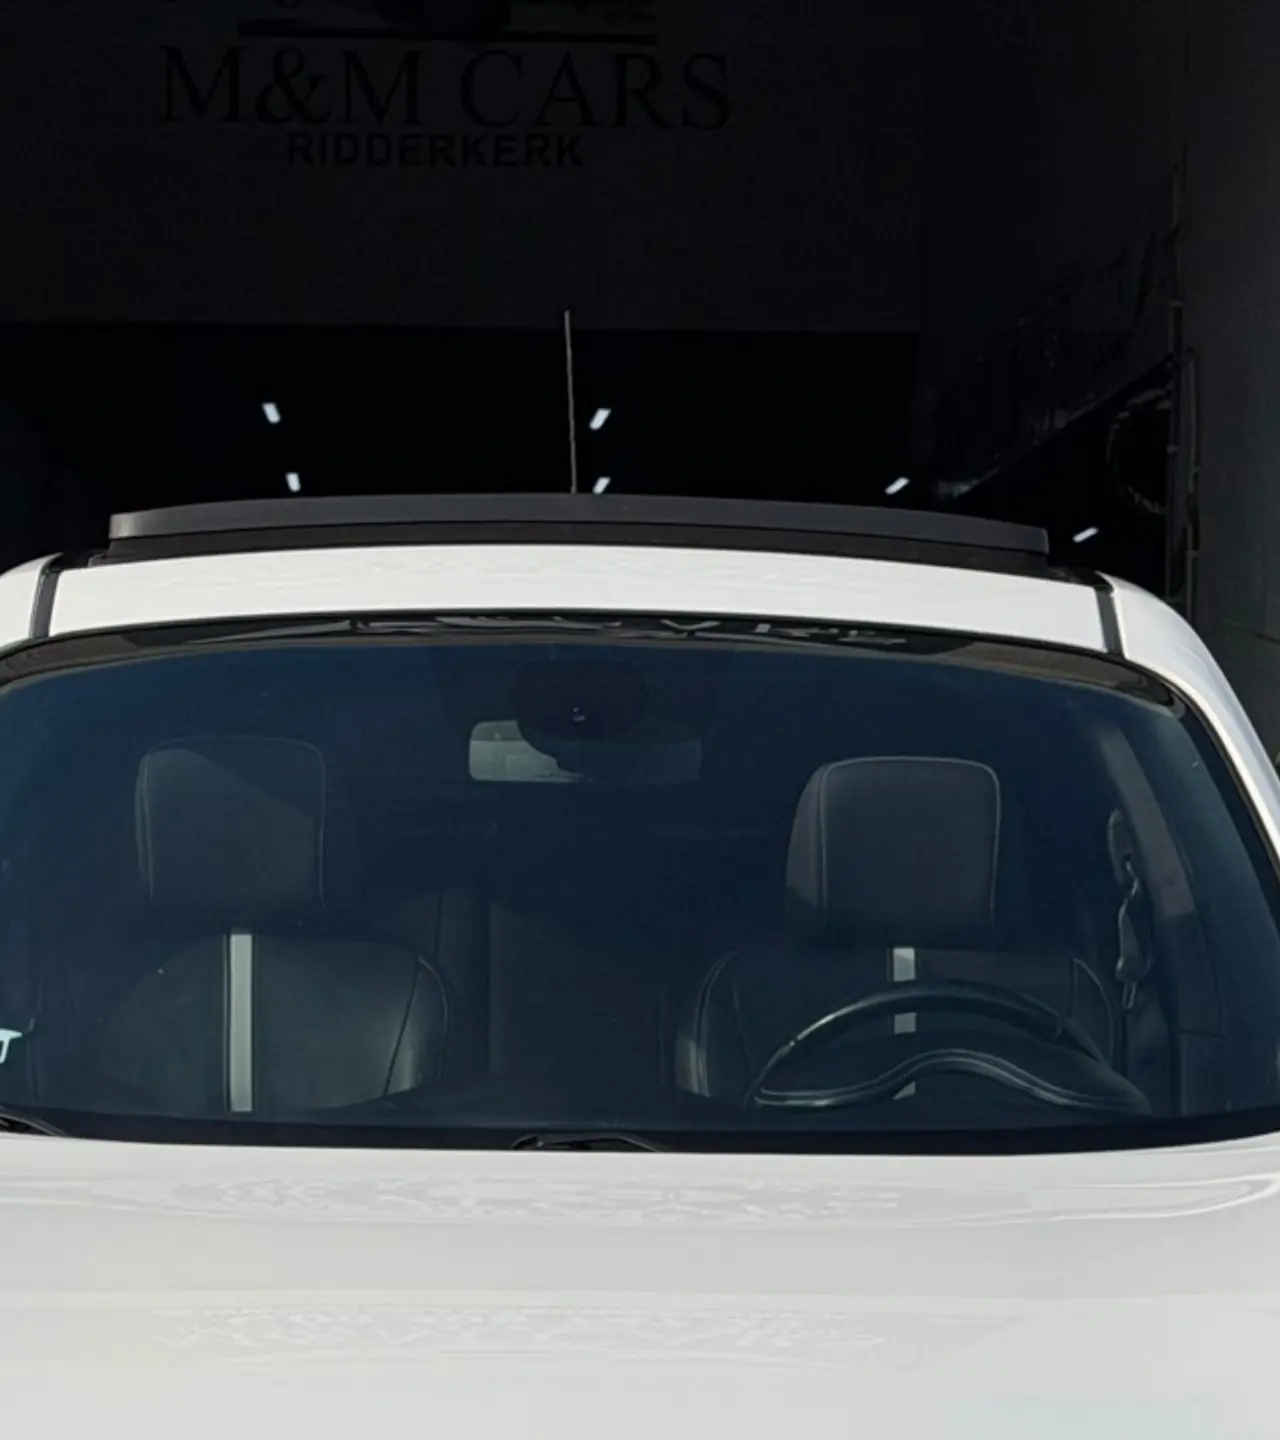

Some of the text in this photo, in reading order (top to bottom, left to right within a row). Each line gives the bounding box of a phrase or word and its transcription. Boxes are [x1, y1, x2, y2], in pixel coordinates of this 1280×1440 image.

[158, 44, 731, 131] M&M CARS
[287, 131, 583, 167] RIDDERKERK
